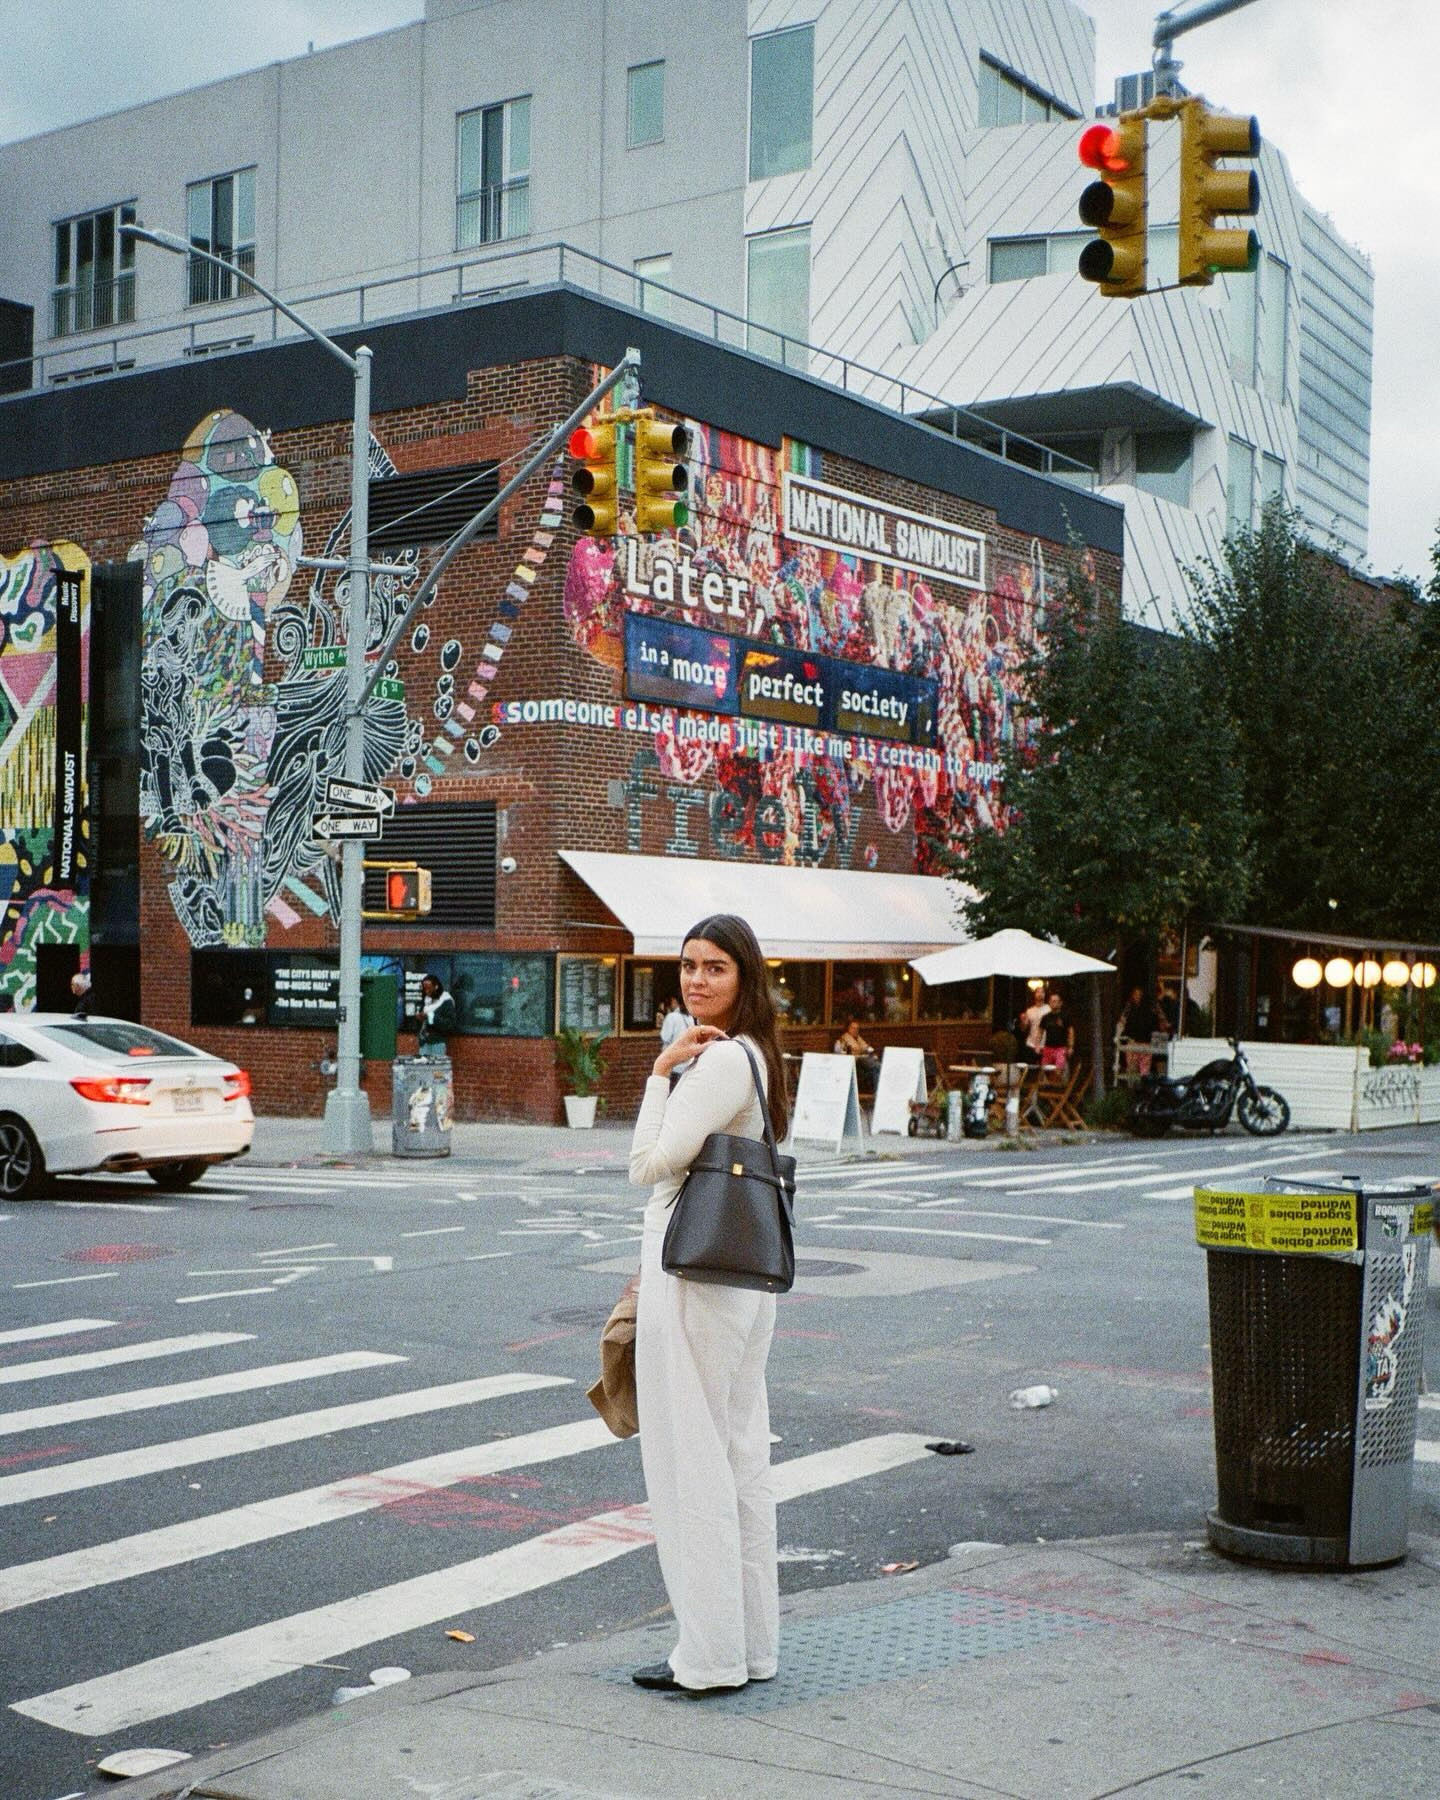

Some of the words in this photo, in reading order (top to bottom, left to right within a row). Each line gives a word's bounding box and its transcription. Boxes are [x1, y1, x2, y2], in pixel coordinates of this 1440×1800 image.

[790, 487, 891, 554] NATIONAL
[896, 519, 978, 576] SAWDUST
[626, 537, 765, 635] Later,
[61, 581, 69, 605] Music
[70, 583, 78, 622] Discovery
[304, 649, 335, 669] Wythe
[640, 641, 657, 662] in
[660, 650, 669, 665] a
[672, 658, 727, 688] more
[749, 672, 824, 707] perfect
[381, 680, 388, 698] 6
[507, 699, 615, 724] someone
[625, 704, 674, 733] else
[680, 714, 730, 743] made
[736, 725, 778, 751] just
[784, 727, 824, 755] like
[829, 737, 851, 758] me
[858, 738, 876, 763] is
[880, 745, 941, 772] certain
[946, 749, 963, 775] to
[64, 751, 75, 815] SAWDUST
[332, 786, 352, 801] ONE
[364, 792, 385, 806] WAY
[320, 821, 341, 832] ONE
[353, 820, 374, 831] WAY
[60, 816, 74, 878] NATIONAL
[290, 998, 303, 1008] New
[304, 999, 318, 1009] York
[318, 999, 337, 1009] Times
[1210, 1196, 1245, 1206] Wanted
[1301, 1200, 1352, 1210] Wanted
[1218, 1205, 1245, 1217] Sugar
[1270, 1209, 1312, 1221] Babies
[1313, 1208, 1352, 1221] Sugar
[1212, 1221, 1246, 1231] Wanted
[1303, 1227, 1353, 1237] Wanted
[1219, 1230, 1246, 1242] Sugar
[1271, 1236, 1313, 1248] Babies
[1315, 1234, 1353, 1247] Sugar
